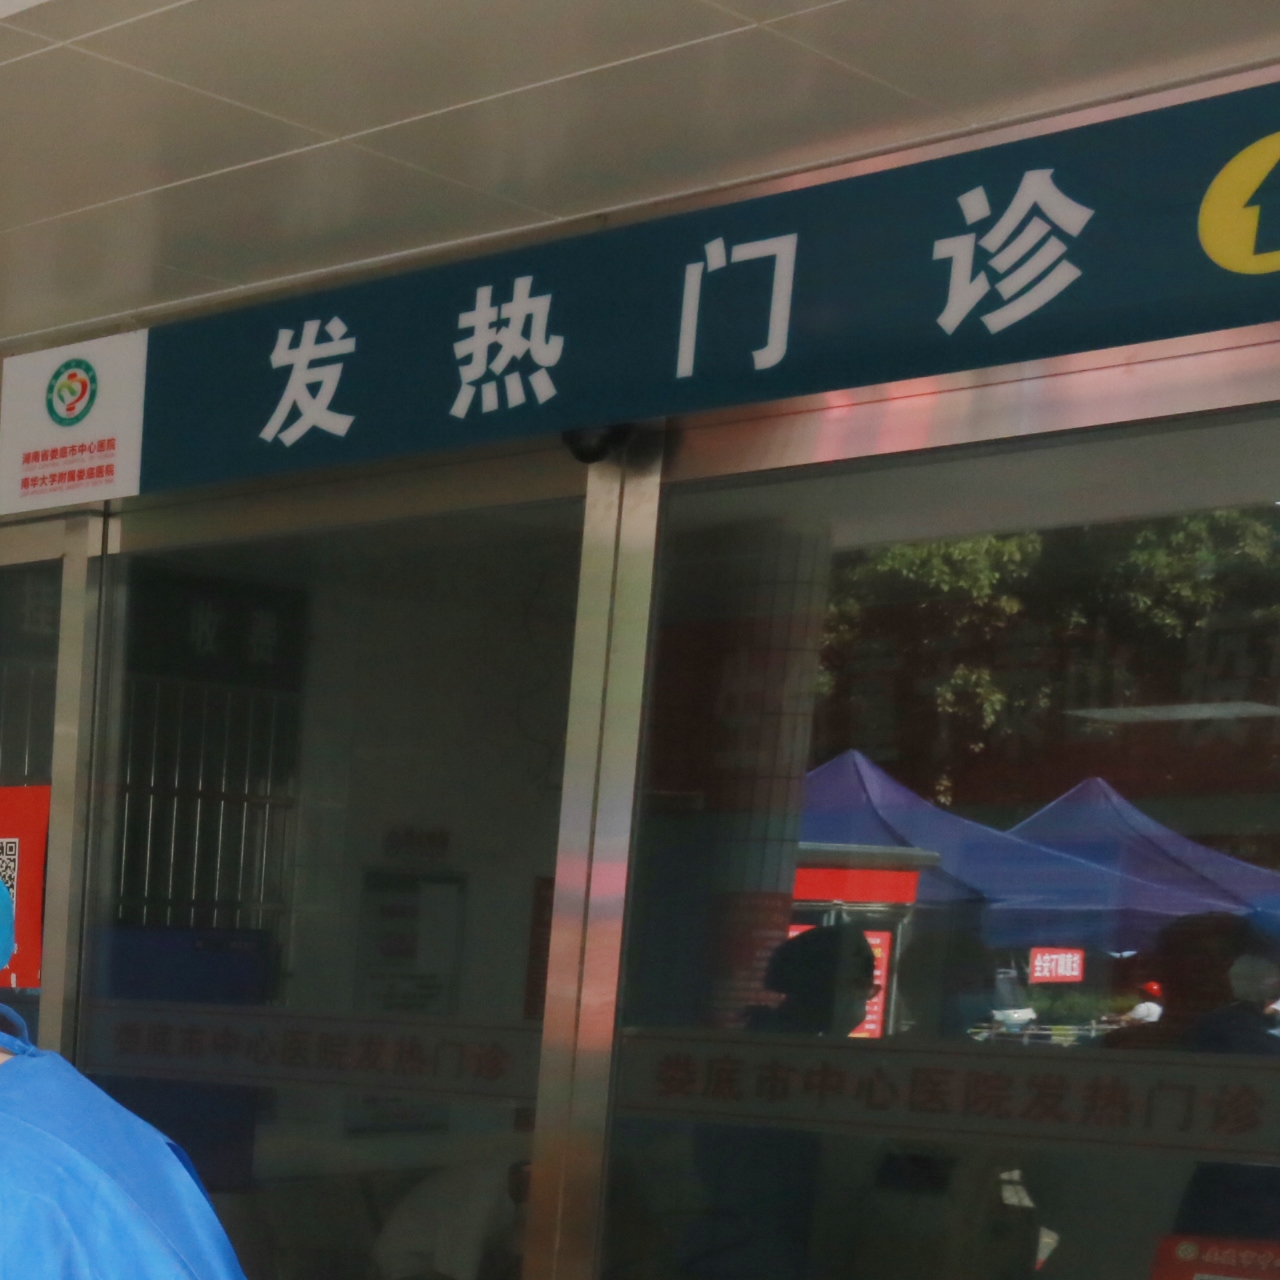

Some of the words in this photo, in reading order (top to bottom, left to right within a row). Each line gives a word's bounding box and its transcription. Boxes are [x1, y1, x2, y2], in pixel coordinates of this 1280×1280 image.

[259, 168, 1095, 447] 发热门诊
[22, 438, 116, 465] 湖南省娄底市中心医院
[654, 1052, 1266, 1135] 娄底市中心医院发热门诊
